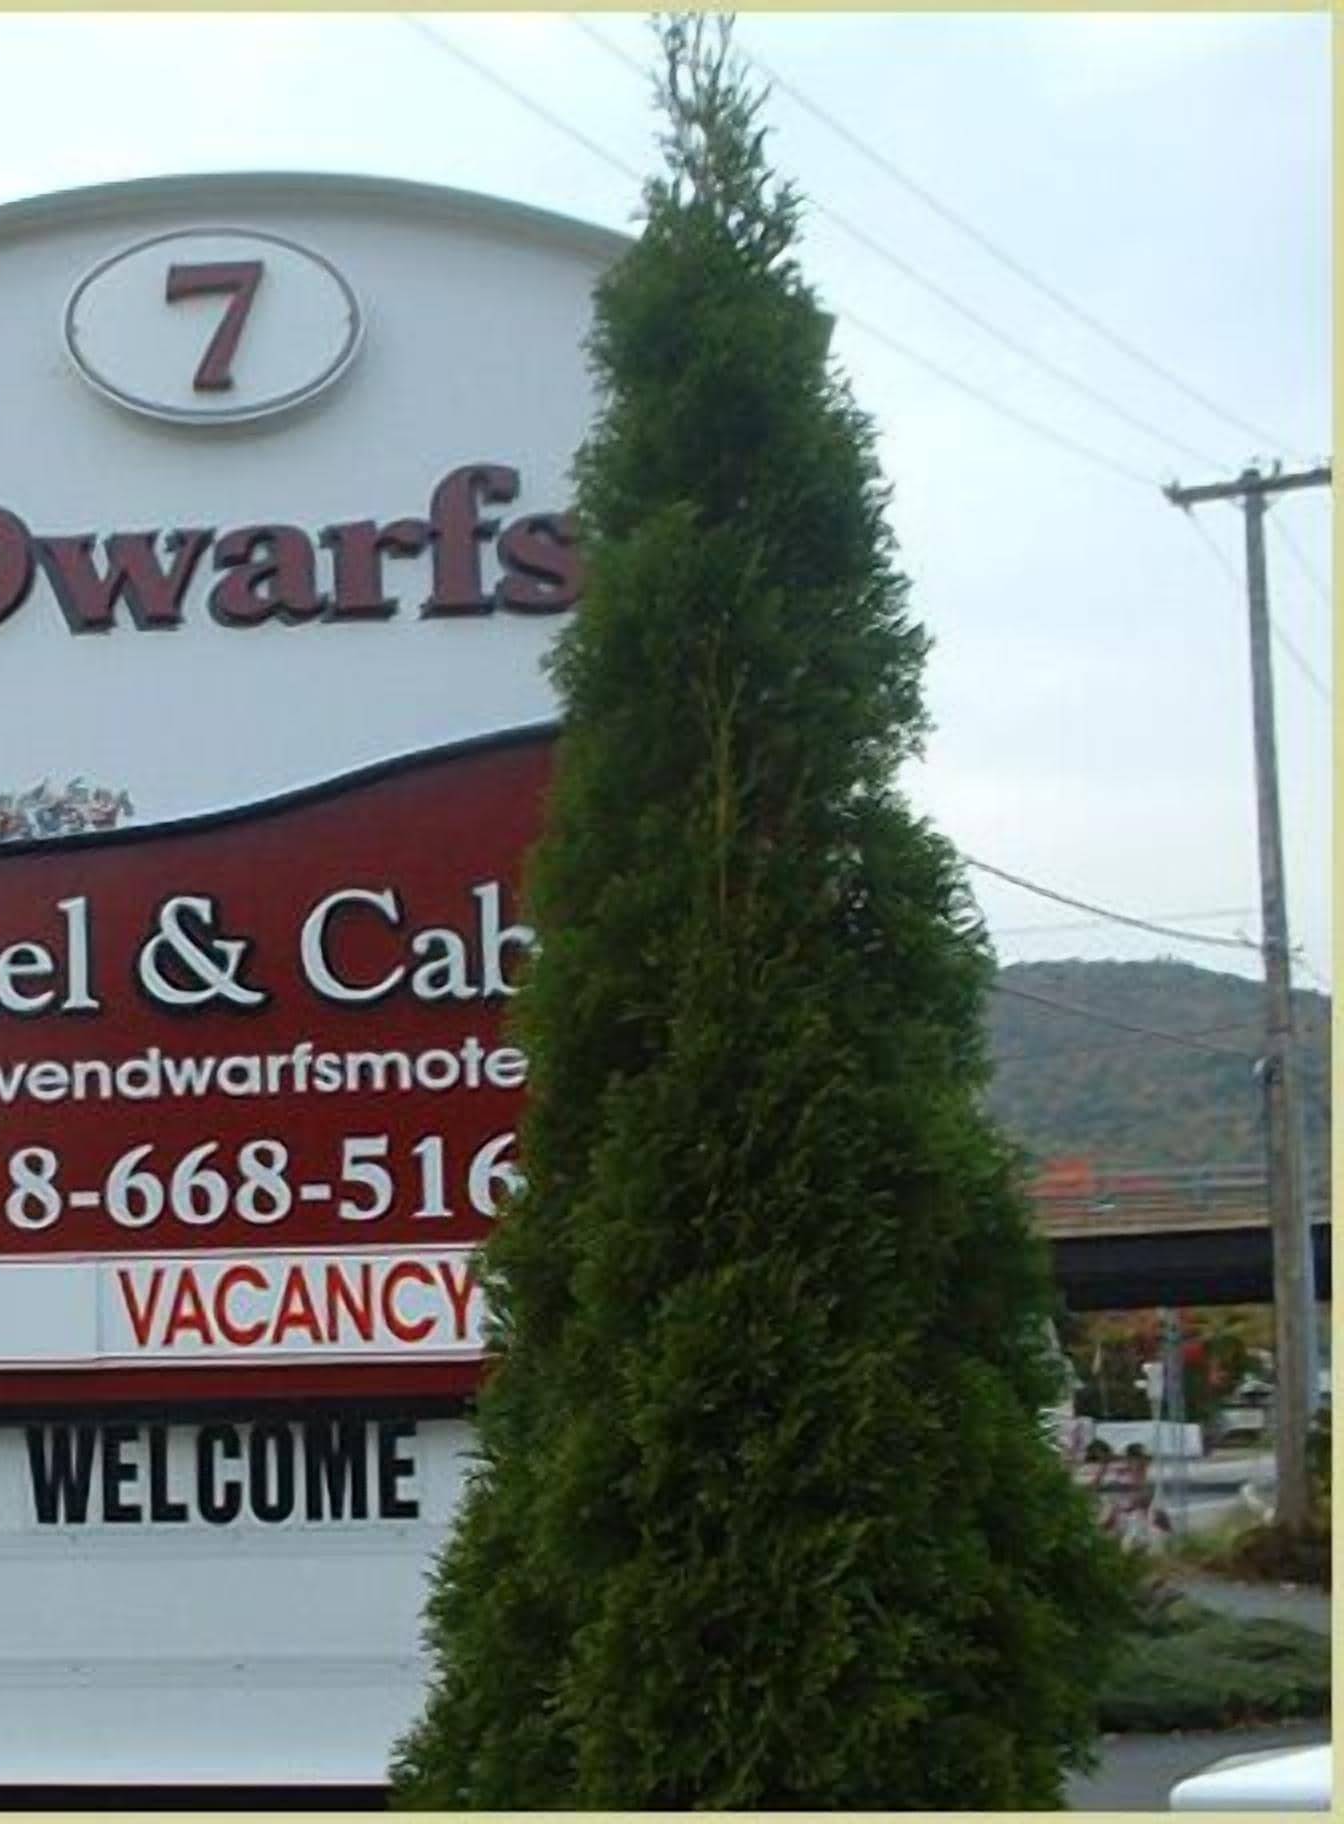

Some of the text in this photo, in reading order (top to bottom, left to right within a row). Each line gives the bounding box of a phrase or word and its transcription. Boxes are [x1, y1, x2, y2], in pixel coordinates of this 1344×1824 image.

[166, 260, 265, 391] 7
[139, 896, 266, 1005] &
[118, 1260, 476, 1346] VACANCY
[26, 1422, 420, 1525] WELCOME
